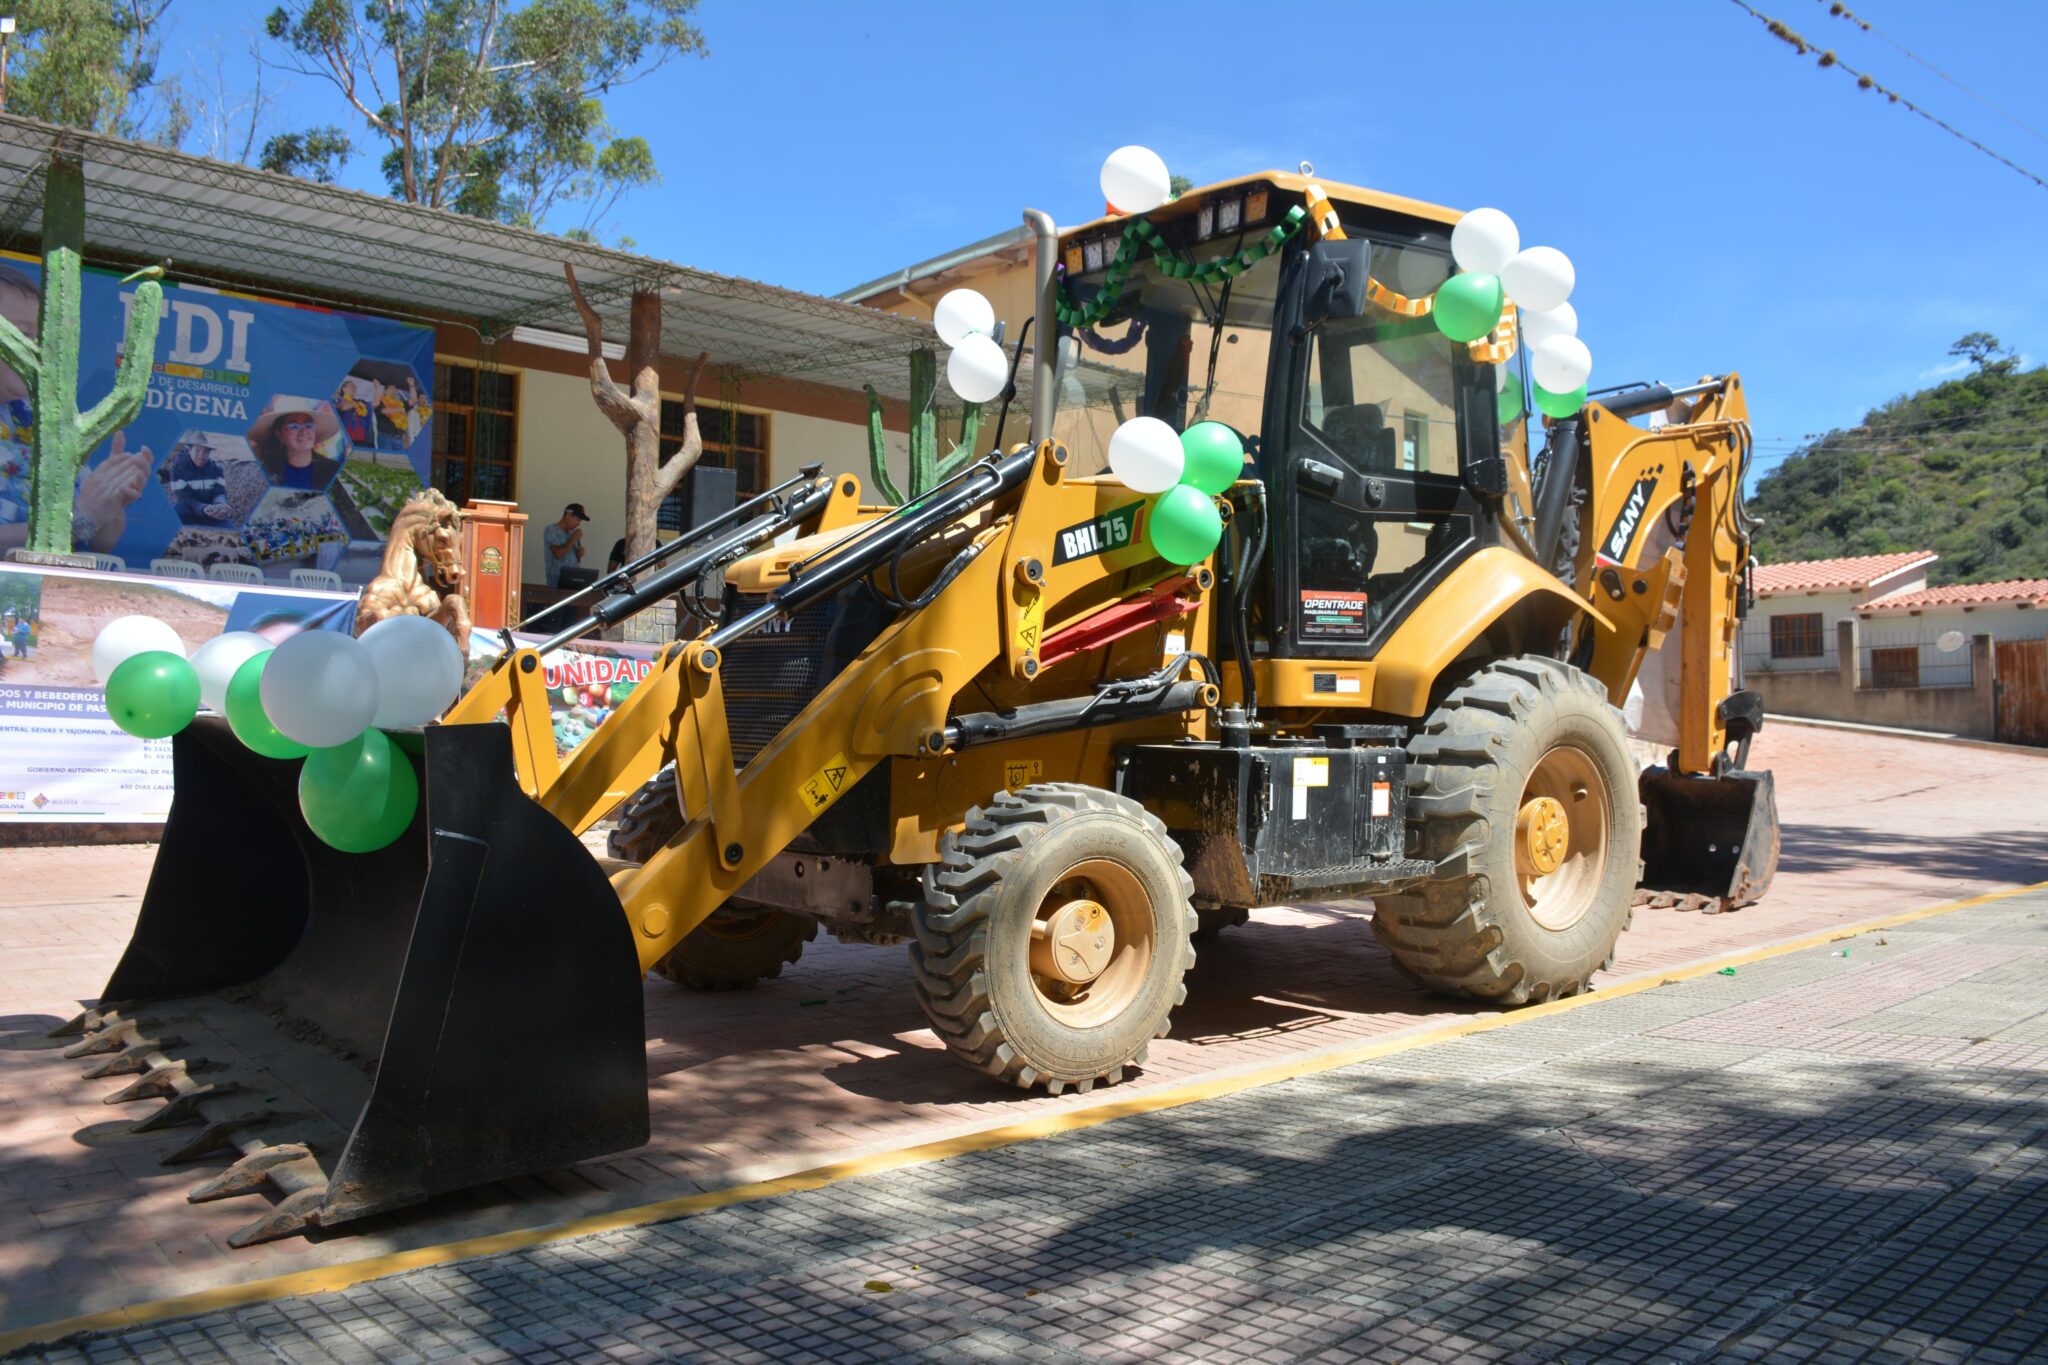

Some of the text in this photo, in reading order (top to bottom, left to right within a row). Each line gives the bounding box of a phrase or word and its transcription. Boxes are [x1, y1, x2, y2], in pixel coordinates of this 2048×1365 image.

[159, 376, 174, 388] DE
[177, 378, 249, 397] DESARROLLO
[145, 386, 249, 420] DÍGENA
[1610, 483, 1645, 559] SANY
[1062, 516, 1128, 559] BHL75
[1304, 599, 1364, 610] OPENTRADE
[543, 658, 655, 689] UNIDAD
[6, 700, 66, 711] MUNICIPIO
[69, 703, 83, 712] DE
[24, 690, 32, 698] Y
[34, 691, 99, 702] BEBEDEROS
